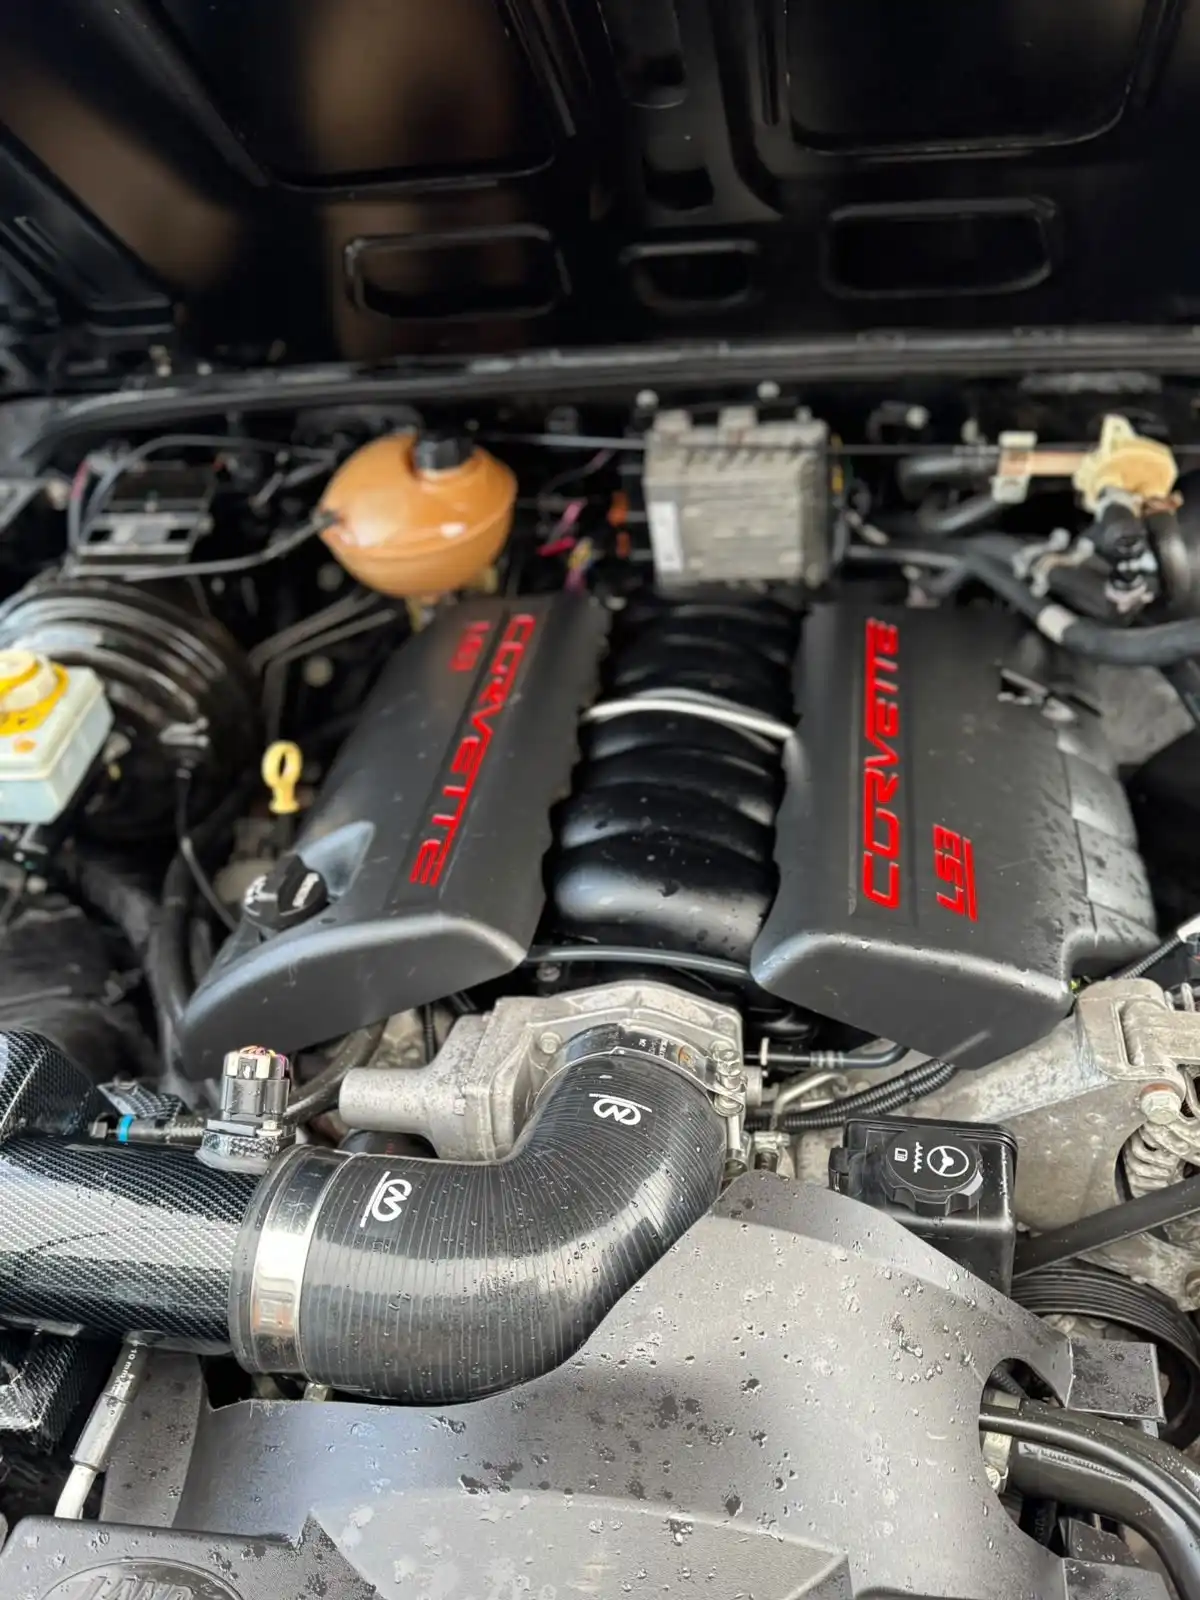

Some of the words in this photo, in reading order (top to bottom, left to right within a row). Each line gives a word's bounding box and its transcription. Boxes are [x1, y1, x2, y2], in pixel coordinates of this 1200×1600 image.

[410, 613, 537, 887] CORVETTE
[863, 617, 899, 910] CORVETTE
[933, 823, 967, 917] LS3
